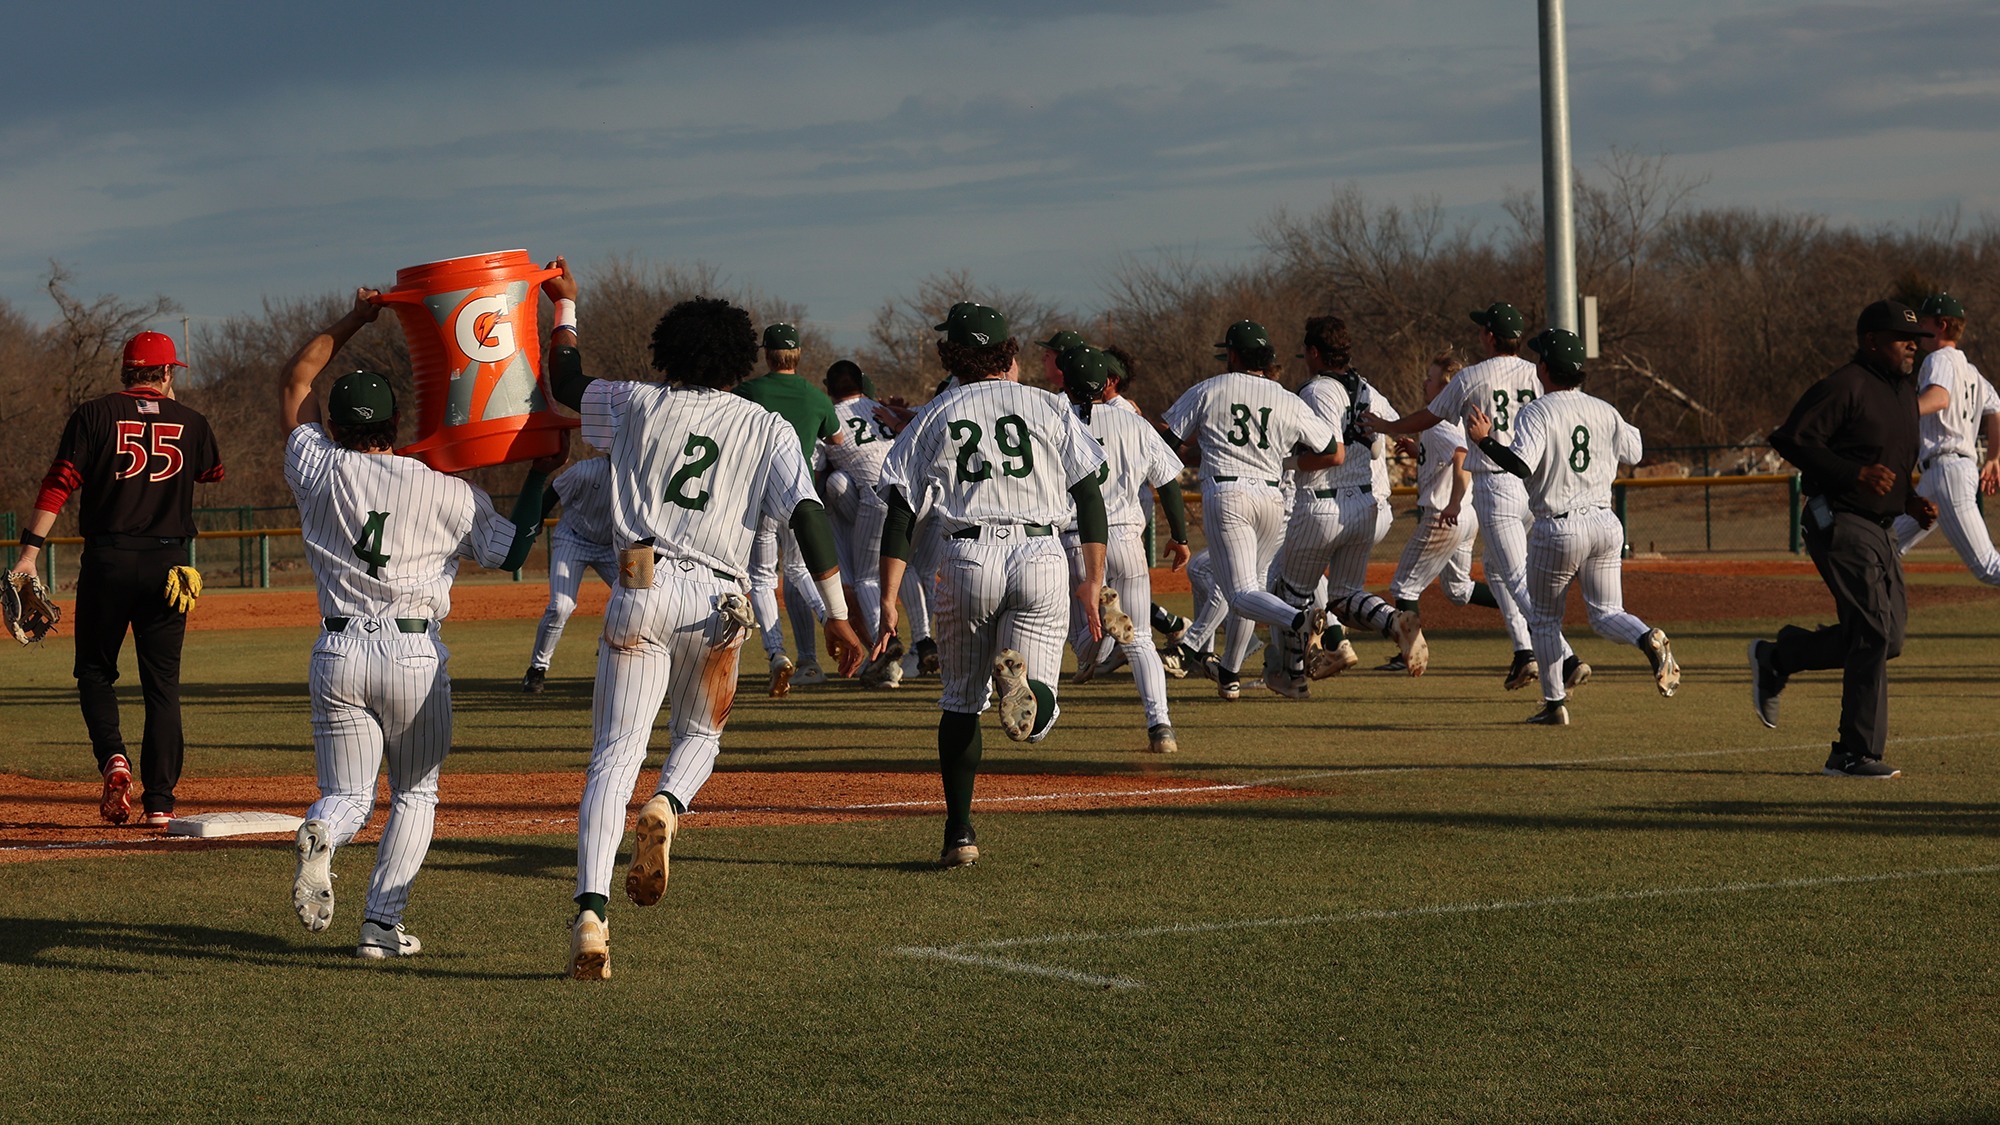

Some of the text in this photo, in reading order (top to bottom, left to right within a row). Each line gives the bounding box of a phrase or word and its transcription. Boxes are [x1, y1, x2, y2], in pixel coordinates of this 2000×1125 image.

[454, 294, 516, 362] G
[115, 420, 184, 482] 55
[947, 414, 1034, 485] 29
[1228, 403, 1273, 450] 31
[1569, 425, 1591, 473] 8
[663, 432, 719, 512] 2
[352, 510, 391, 581] 4
